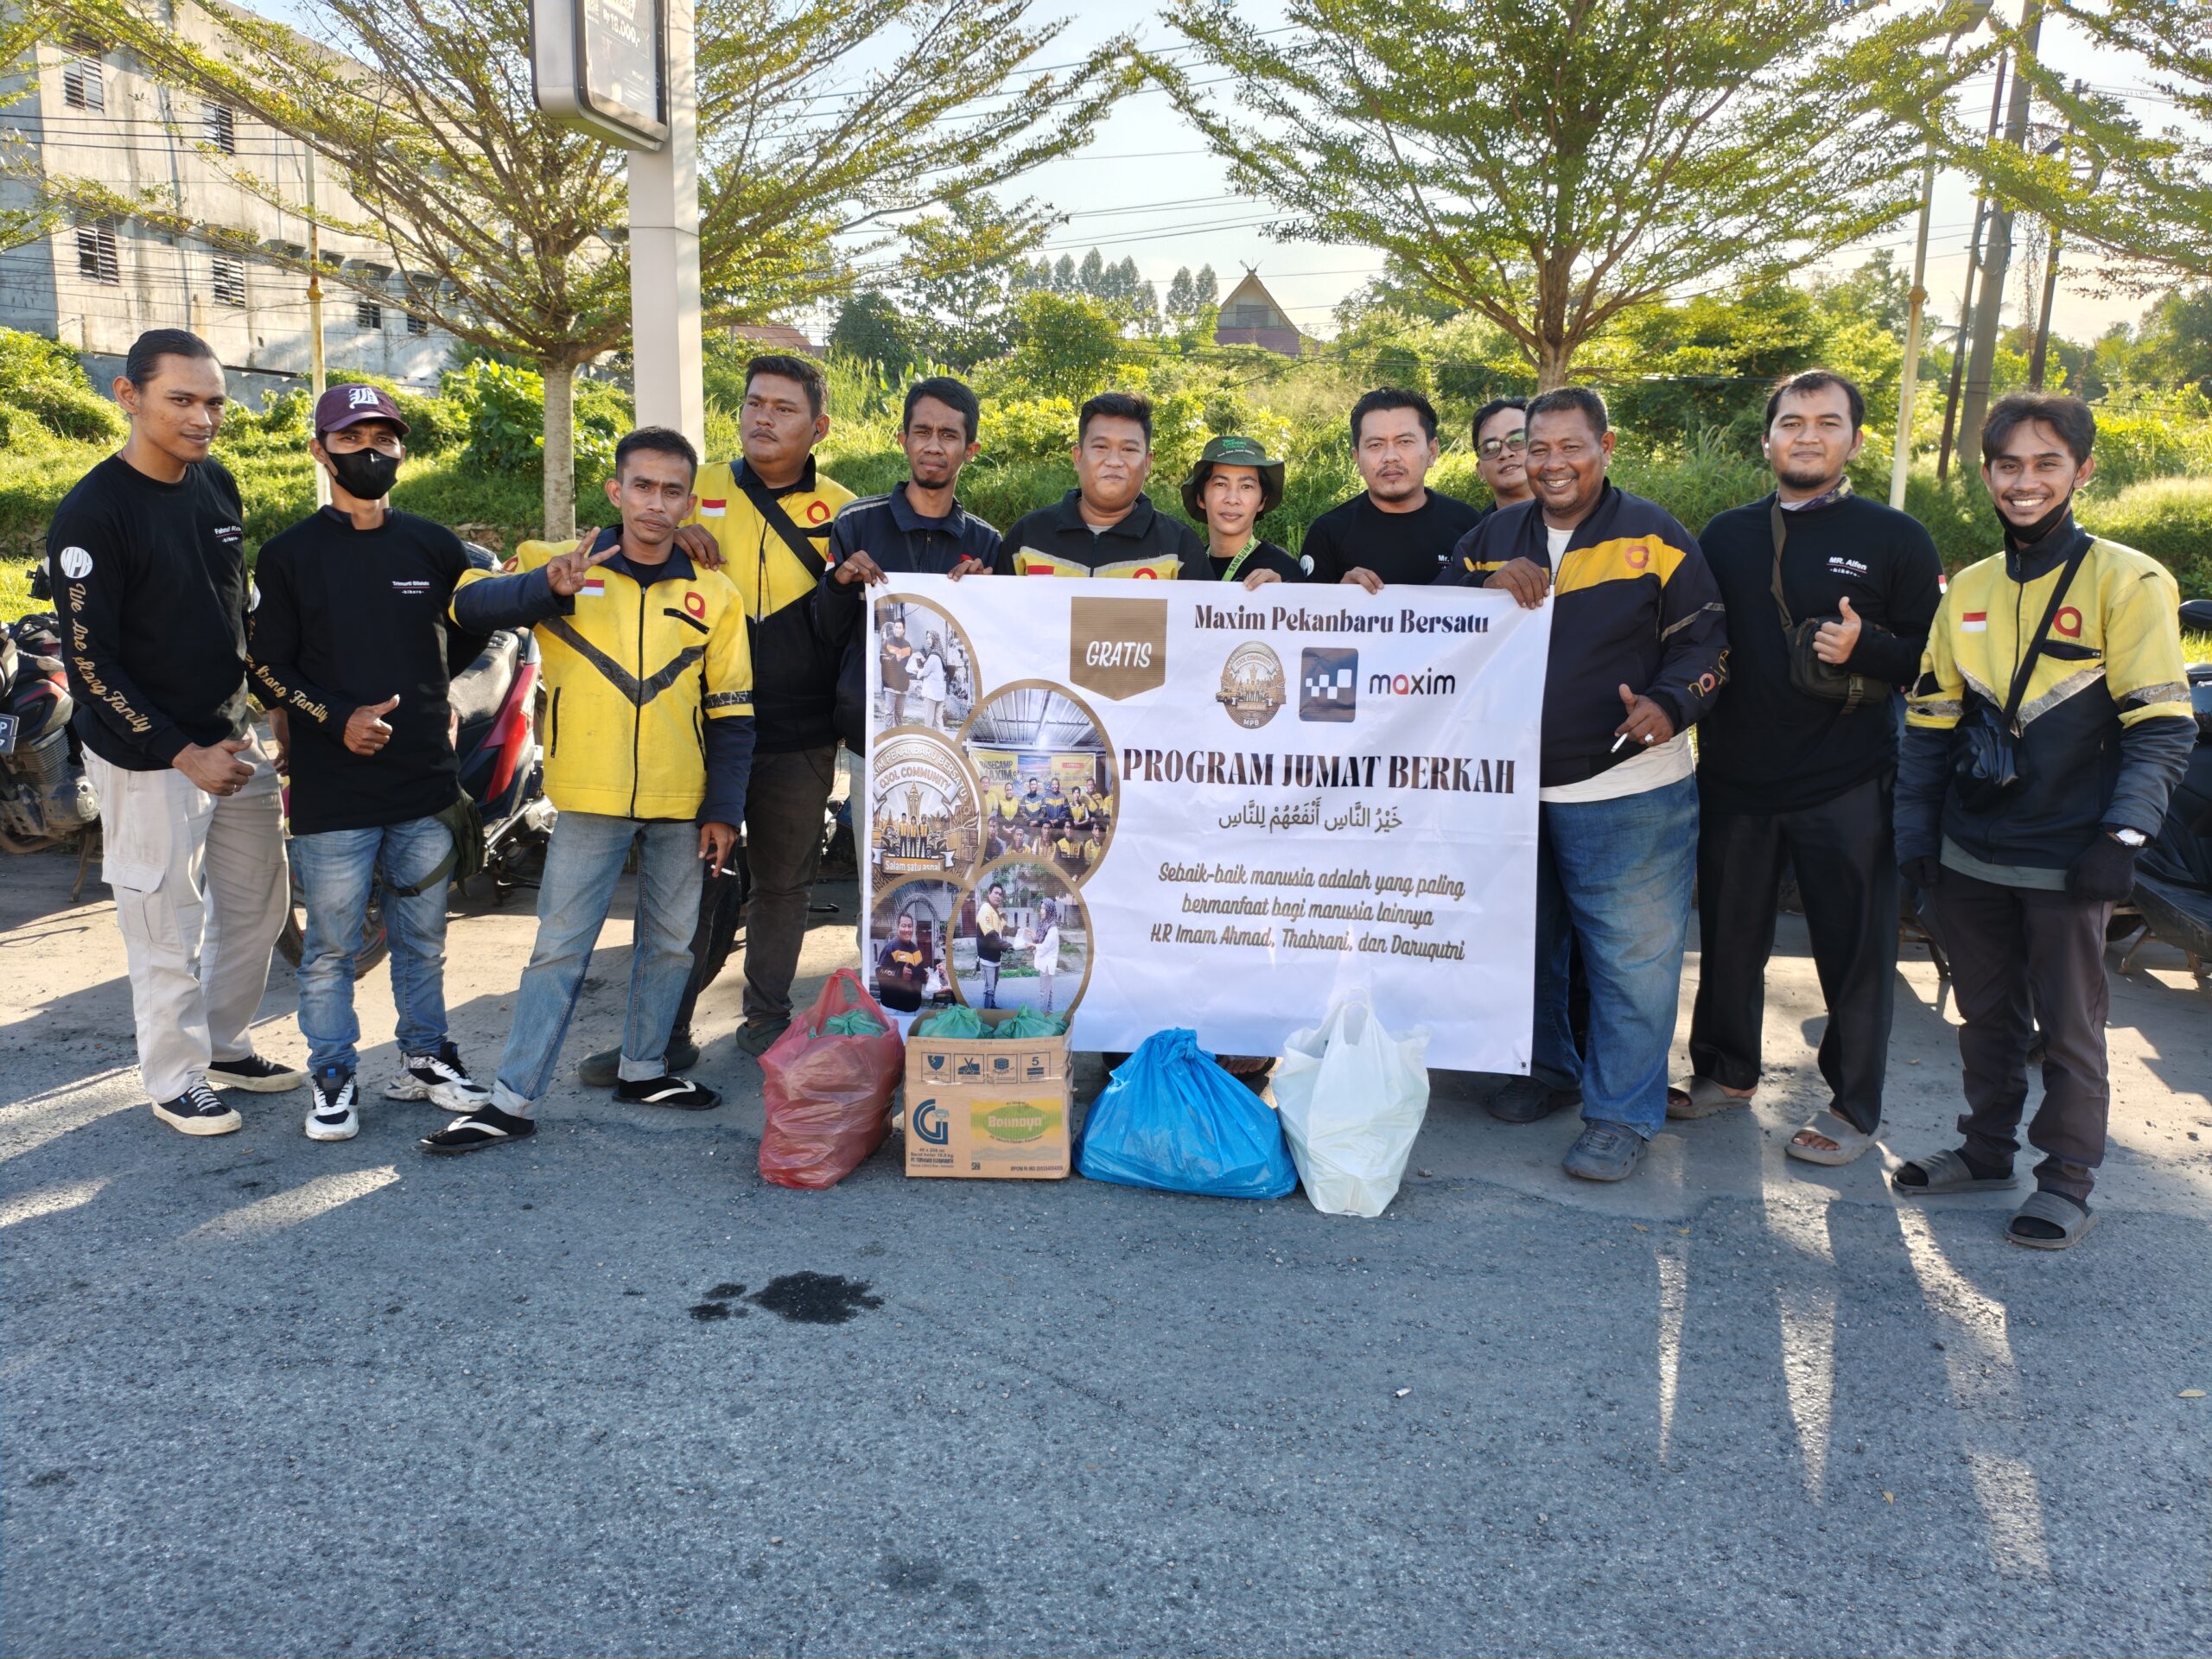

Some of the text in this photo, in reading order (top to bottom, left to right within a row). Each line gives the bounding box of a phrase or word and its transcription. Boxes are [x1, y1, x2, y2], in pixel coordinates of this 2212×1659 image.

[1228, 542, 1253, 572] SAMSUNG
[68, 582, 86, 613] We
[72, 618, 89, 652] Are
[1194, 605, 1489, 634] Maxim Pekanbaru Bersatu
[1086, 640, 1153, 668] GRATIS
[1369, 667, 1456, 695] maxim
[102, 690, 153, 733] Family
[880, 766, 951, 791] OJOL COMMUNITY
[886, 745, 937, 764] PEKANBARU
[939, 755, 969, 798] BERSATU
[1122, 748, 1516, 794] PROGRAM JUMAT BERKAH
[885, 860, 906, 871] Salam
[906, 861, 922, 872] satu
[1158, 861, 1466, 902] Sebaik-baik manusia adalah yang paling
[1181, 892, 1434, 931] bermanfaat bagi manusia lainnya
[1150, 923, 1466, 963] H.R Imam Ahmad, Thabrani, dan Daruqutni
[1031, 1056, 1040, 1067] 5
